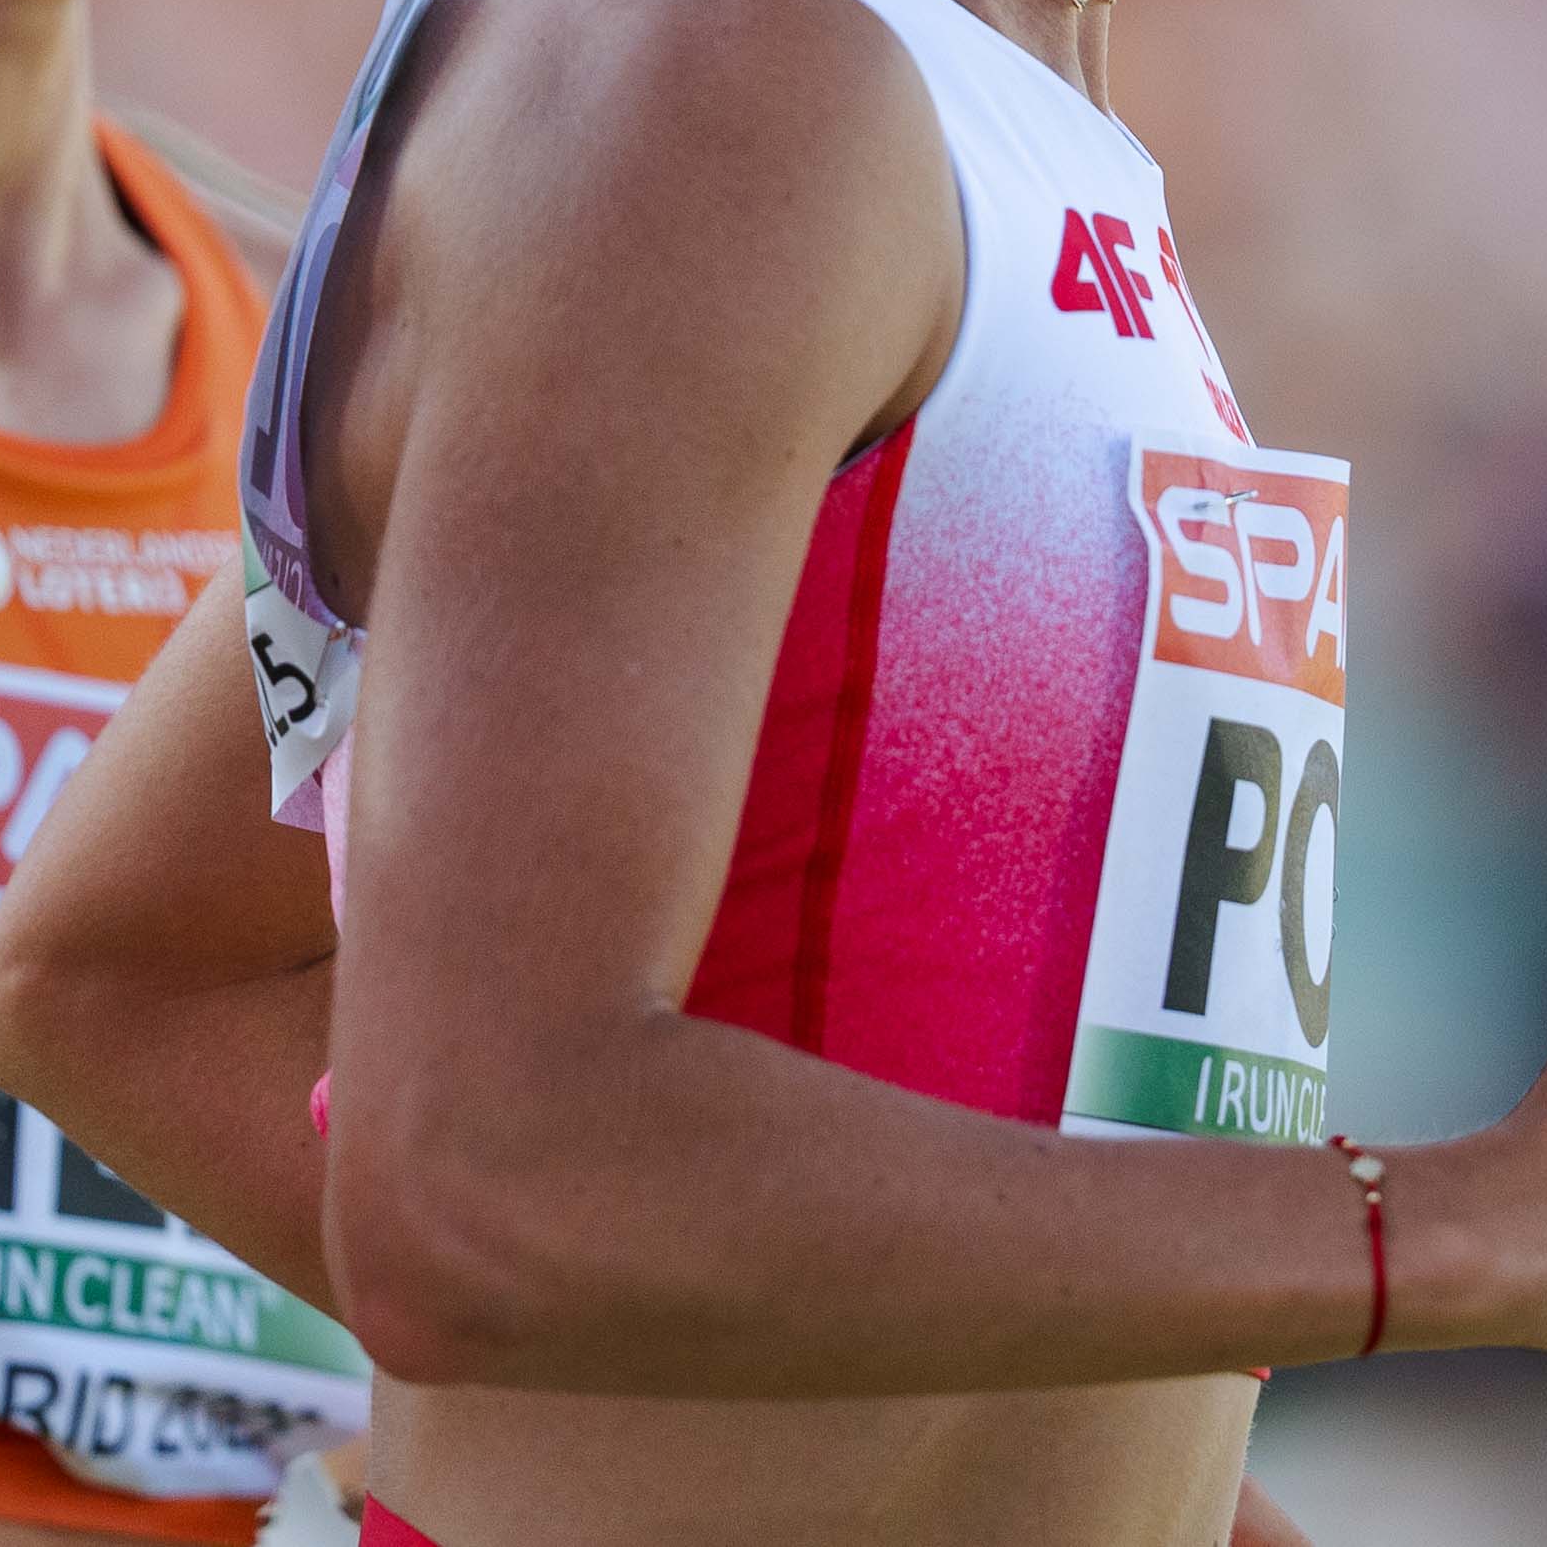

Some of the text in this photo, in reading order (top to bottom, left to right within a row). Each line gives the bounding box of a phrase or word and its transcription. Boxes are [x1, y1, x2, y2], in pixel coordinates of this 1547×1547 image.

[1050, 207, 1155, 340] 4F
[1194, 1055, 1213, 1124] I
[1216, 1058, 1296, 1139] RUN
[62, 1254, 261, 1350] CLEAN
